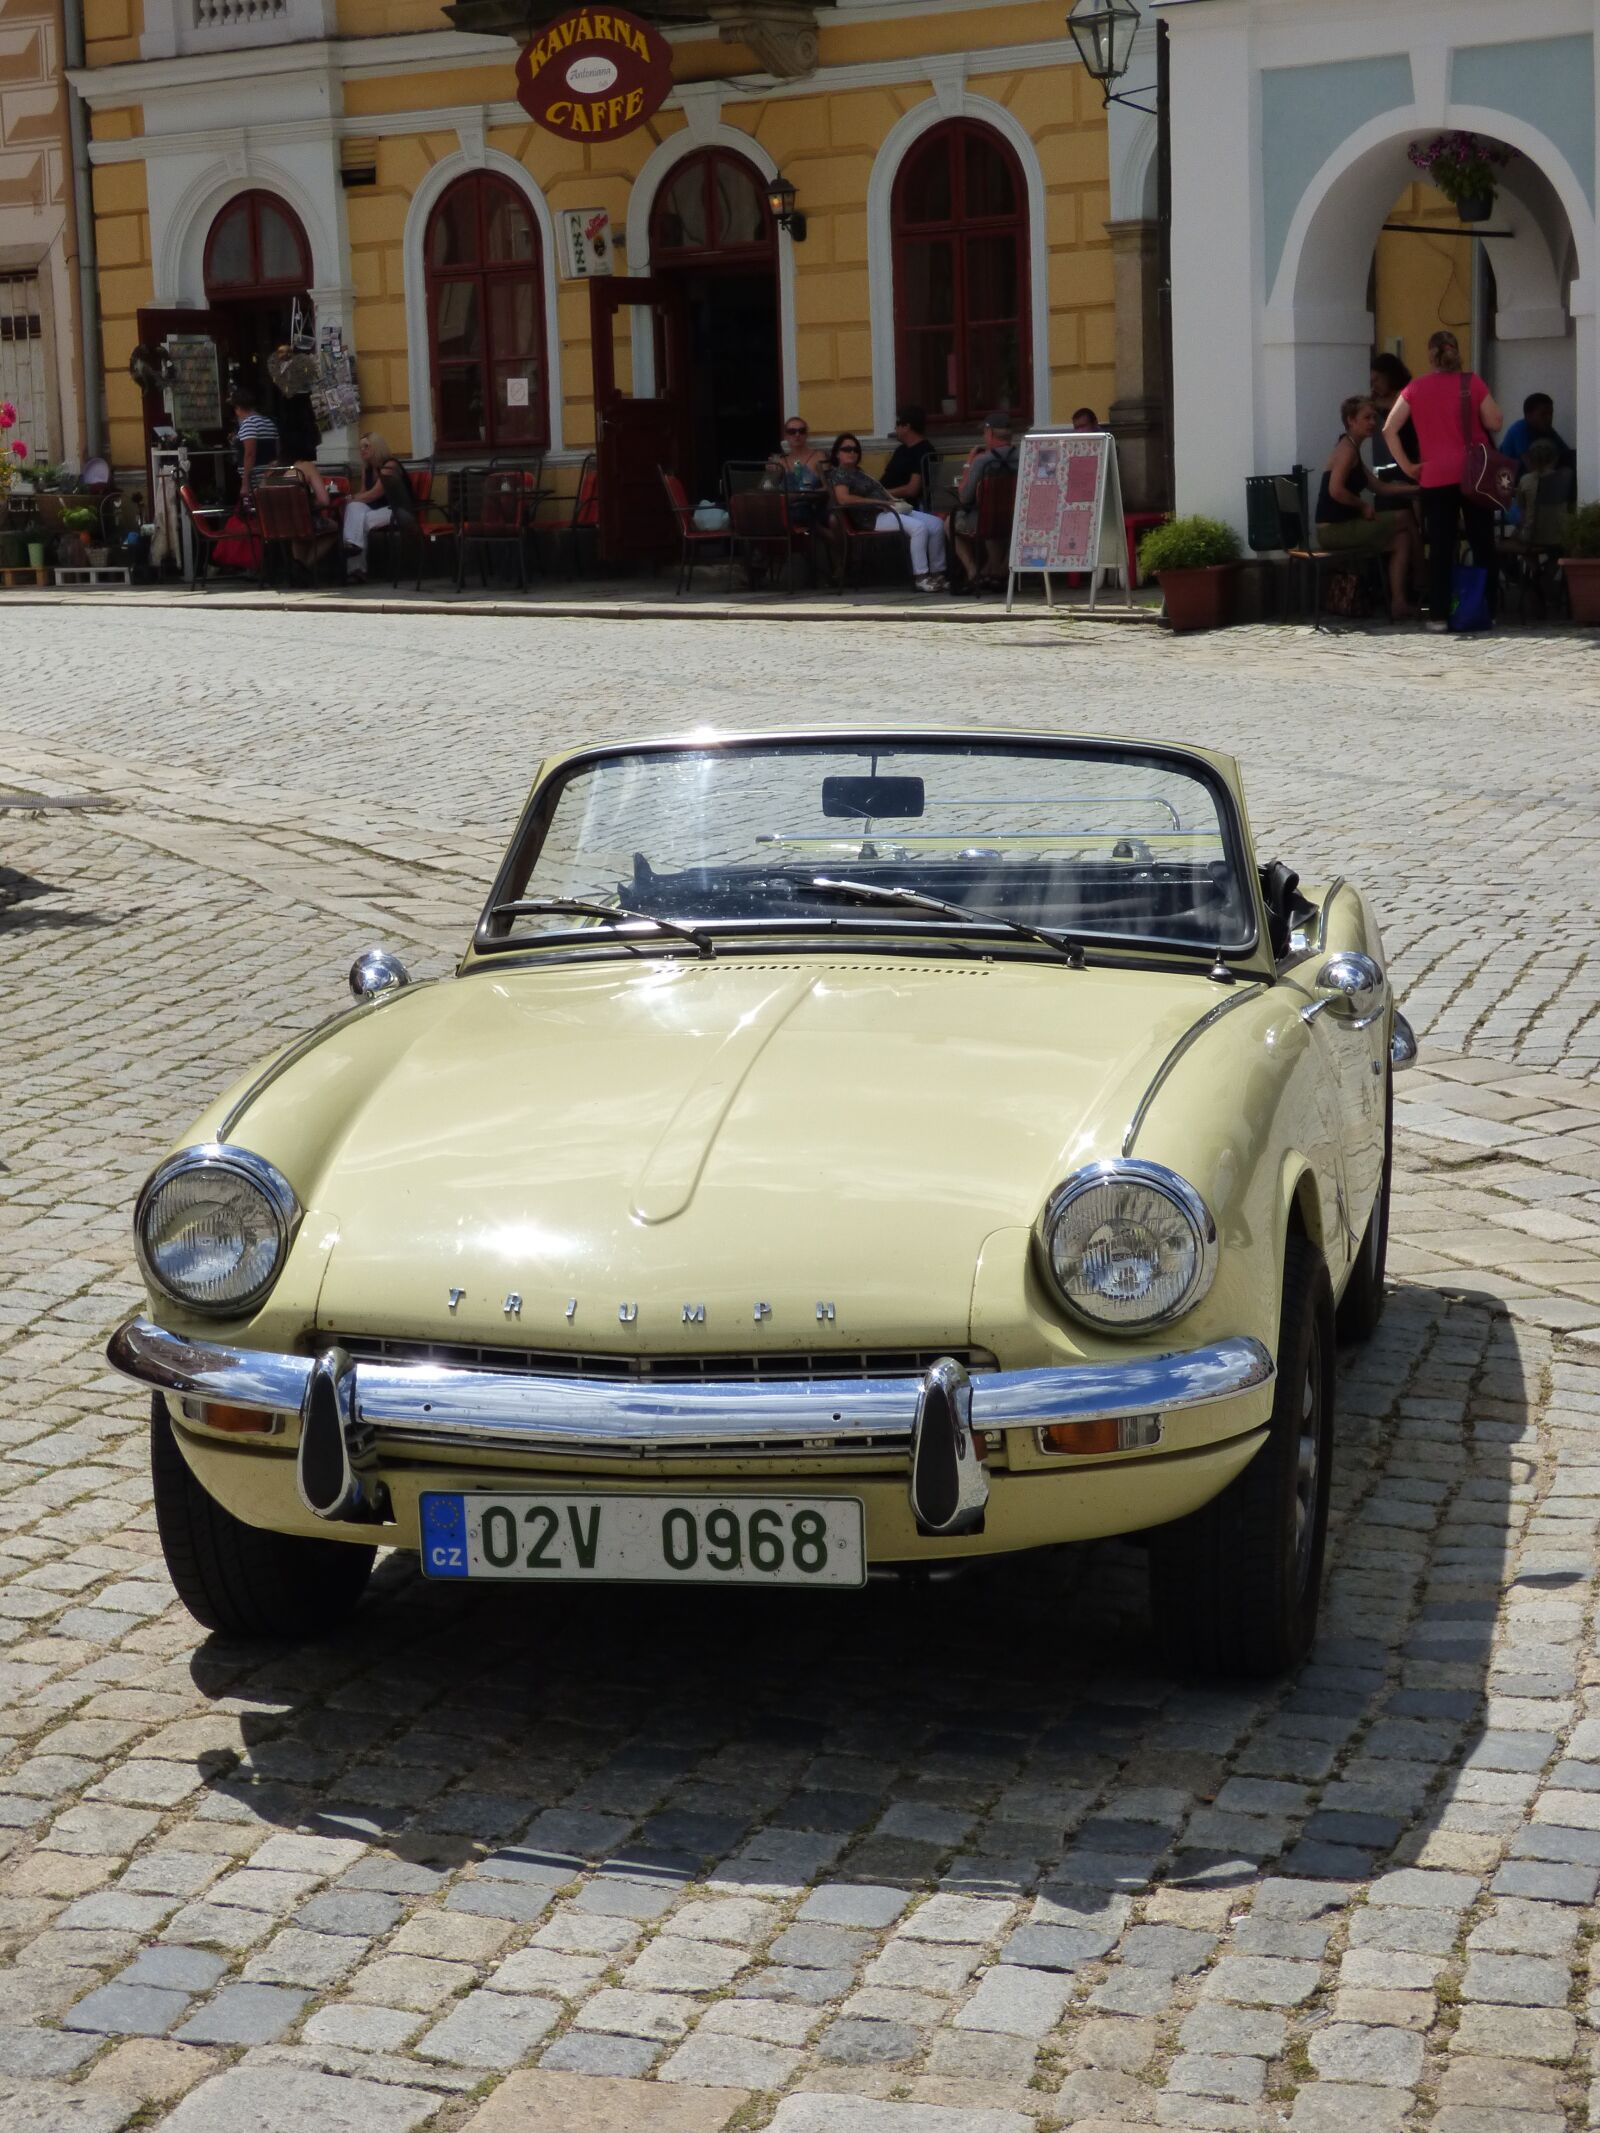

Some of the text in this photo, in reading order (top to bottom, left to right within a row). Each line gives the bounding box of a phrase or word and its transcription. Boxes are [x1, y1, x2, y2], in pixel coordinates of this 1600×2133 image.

[529, 8, 651, 79] KAVÁRNA
[545, 87, 644, 132] CAFFE
[447, 1287, 836, 1322] TRIUMPH
[432, 1547, 462, 1567] CZ
[481, 1505, 828, 1573] 02V 0968
